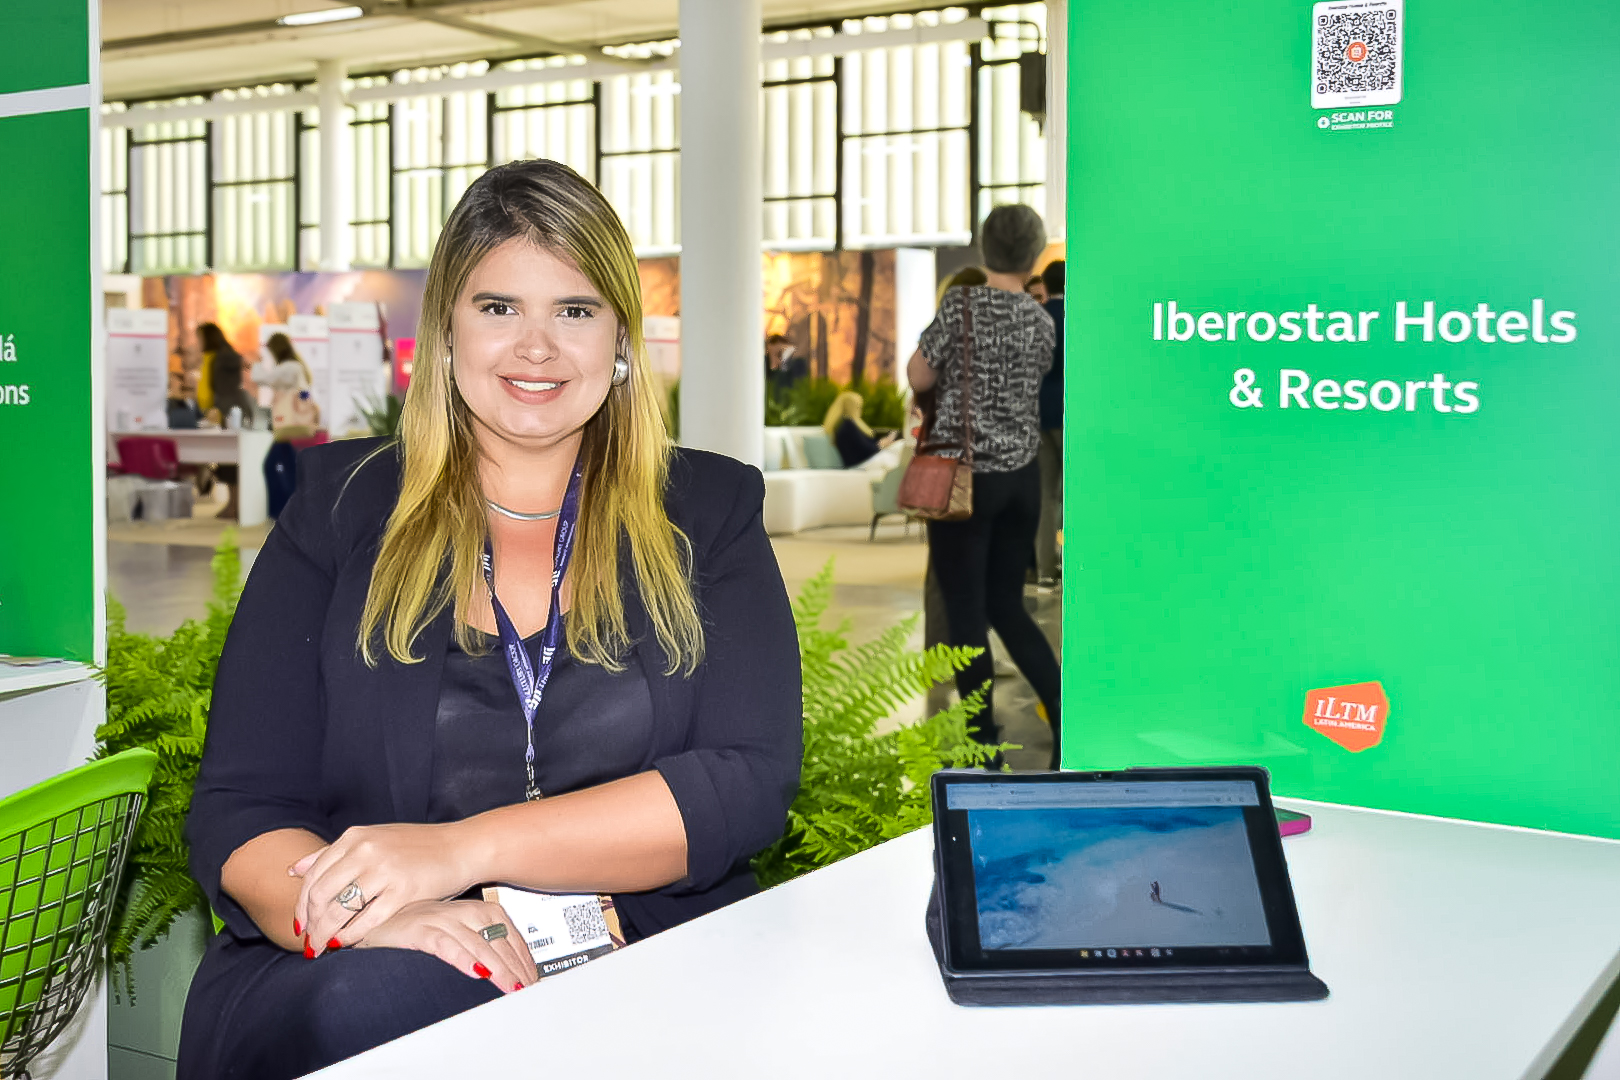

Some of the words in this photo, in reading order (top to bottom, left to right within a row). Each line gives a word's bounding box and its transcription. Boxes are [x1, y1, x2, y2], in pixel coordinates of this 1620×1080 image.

[1331, 111, 1365, 123] SCAN
[1367, 110, 1393, 121] FOR
[1152, 300, 1380, 342] Iberostar
[1394, 298, 1578, 344] Hotels
[1228, 367, 1264, 409] &
[1279, 368, 1480, 414] Resorts
[543, 954, 589, 973] EXHIBITOR
